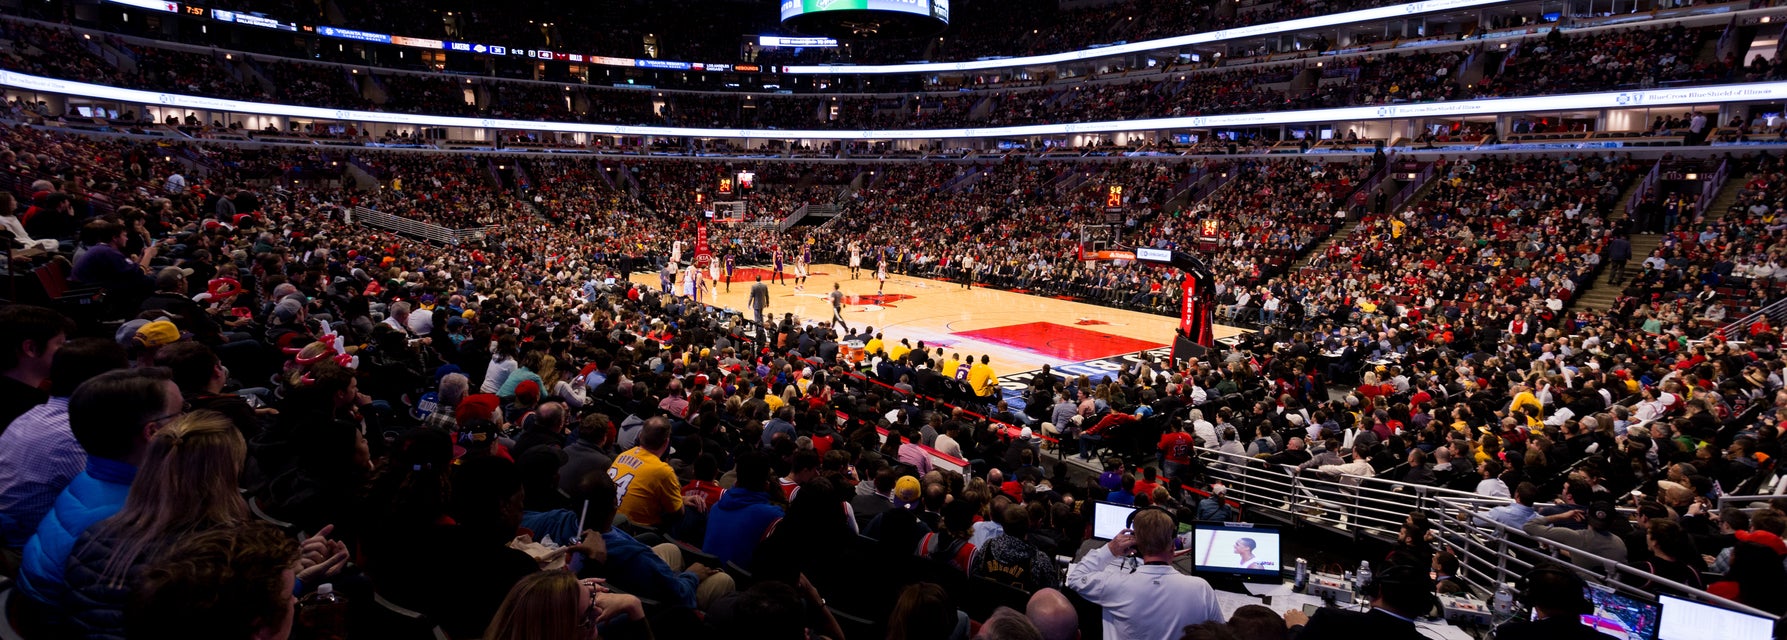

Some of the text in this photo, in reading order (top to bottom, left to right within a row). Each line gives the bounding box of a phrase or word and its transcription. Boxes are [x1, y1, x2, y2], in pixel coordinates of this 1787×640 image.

[186, 6, 203, 15] 7:57
[452, 43, 470, 51] LAKERS
[1108, 194, 1120, 206] 24
[1204, 228, 1214, 236] 24
[1186, 314, 1192, 325] TV
[957, 371, 965, 379] 6
